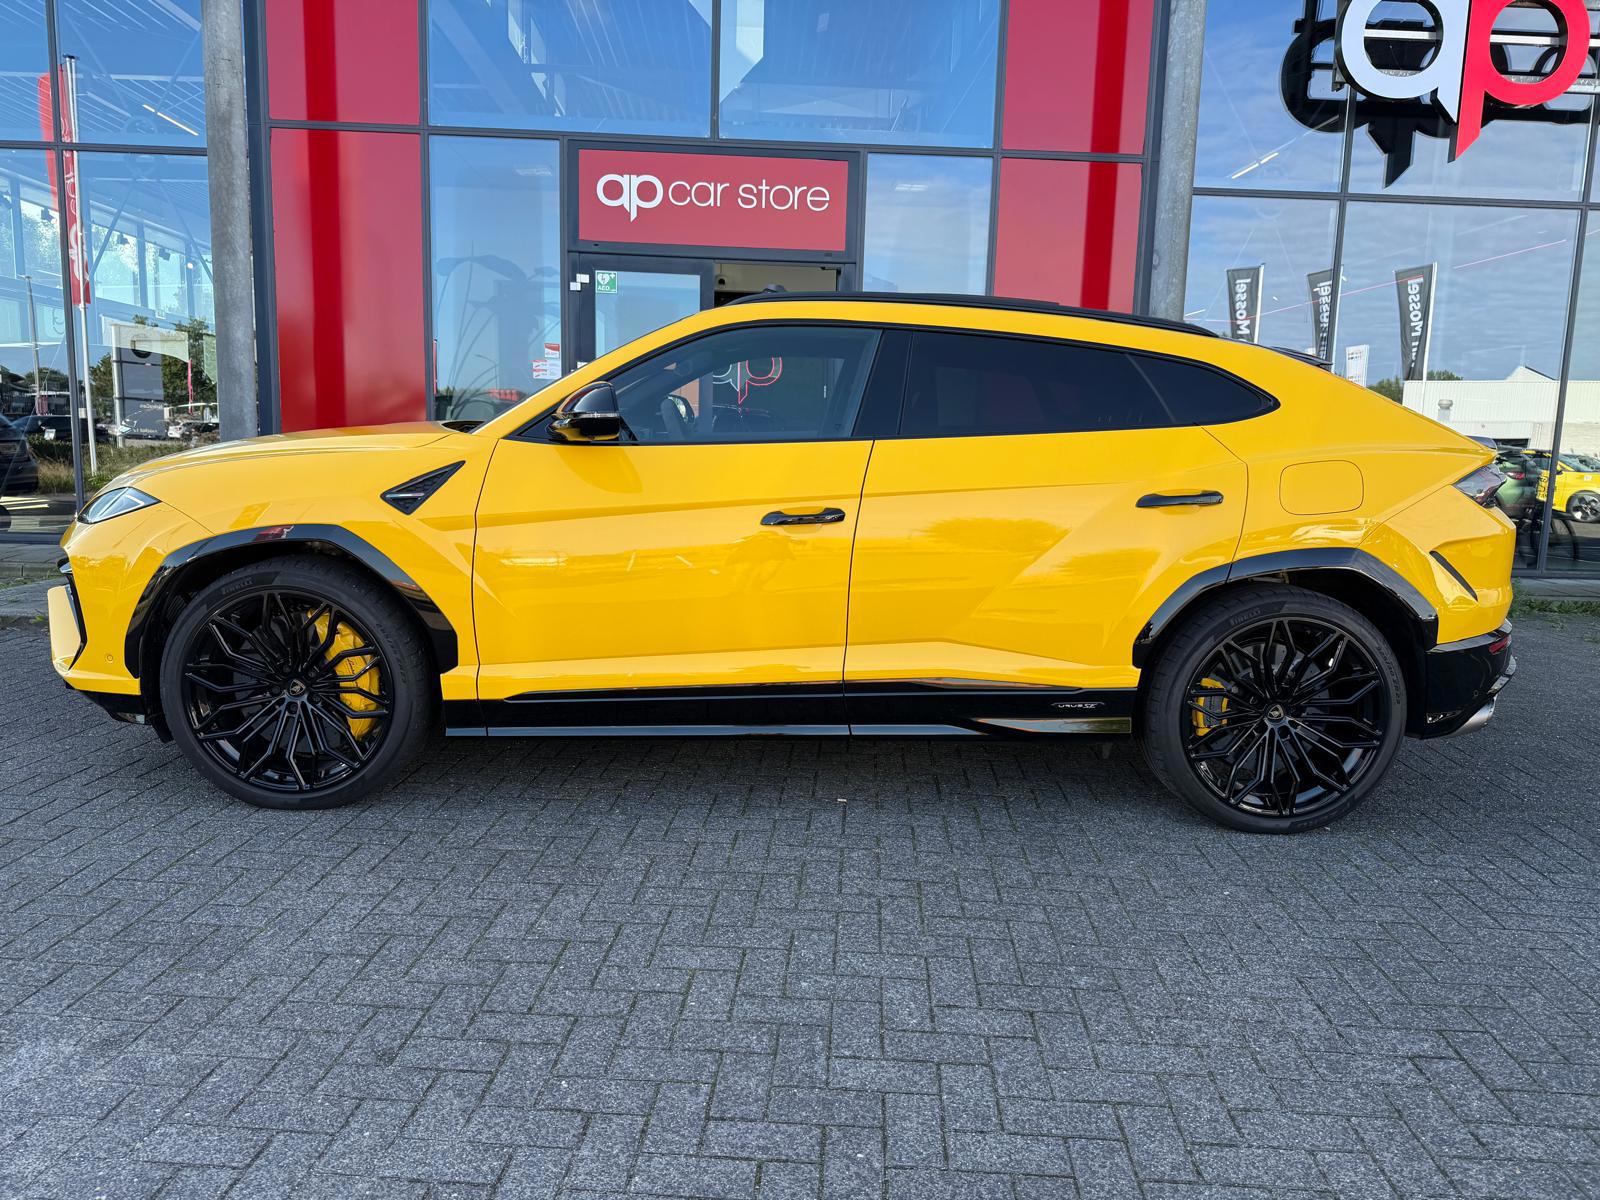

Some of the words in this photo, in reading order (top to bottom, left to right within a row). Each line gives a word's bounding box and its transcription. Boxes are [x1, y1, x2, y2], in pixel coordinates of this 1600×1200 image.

[596, 173, 664, 223] ap
[668, 181, 730, 209] car
[737, 178, 830, 212] store
